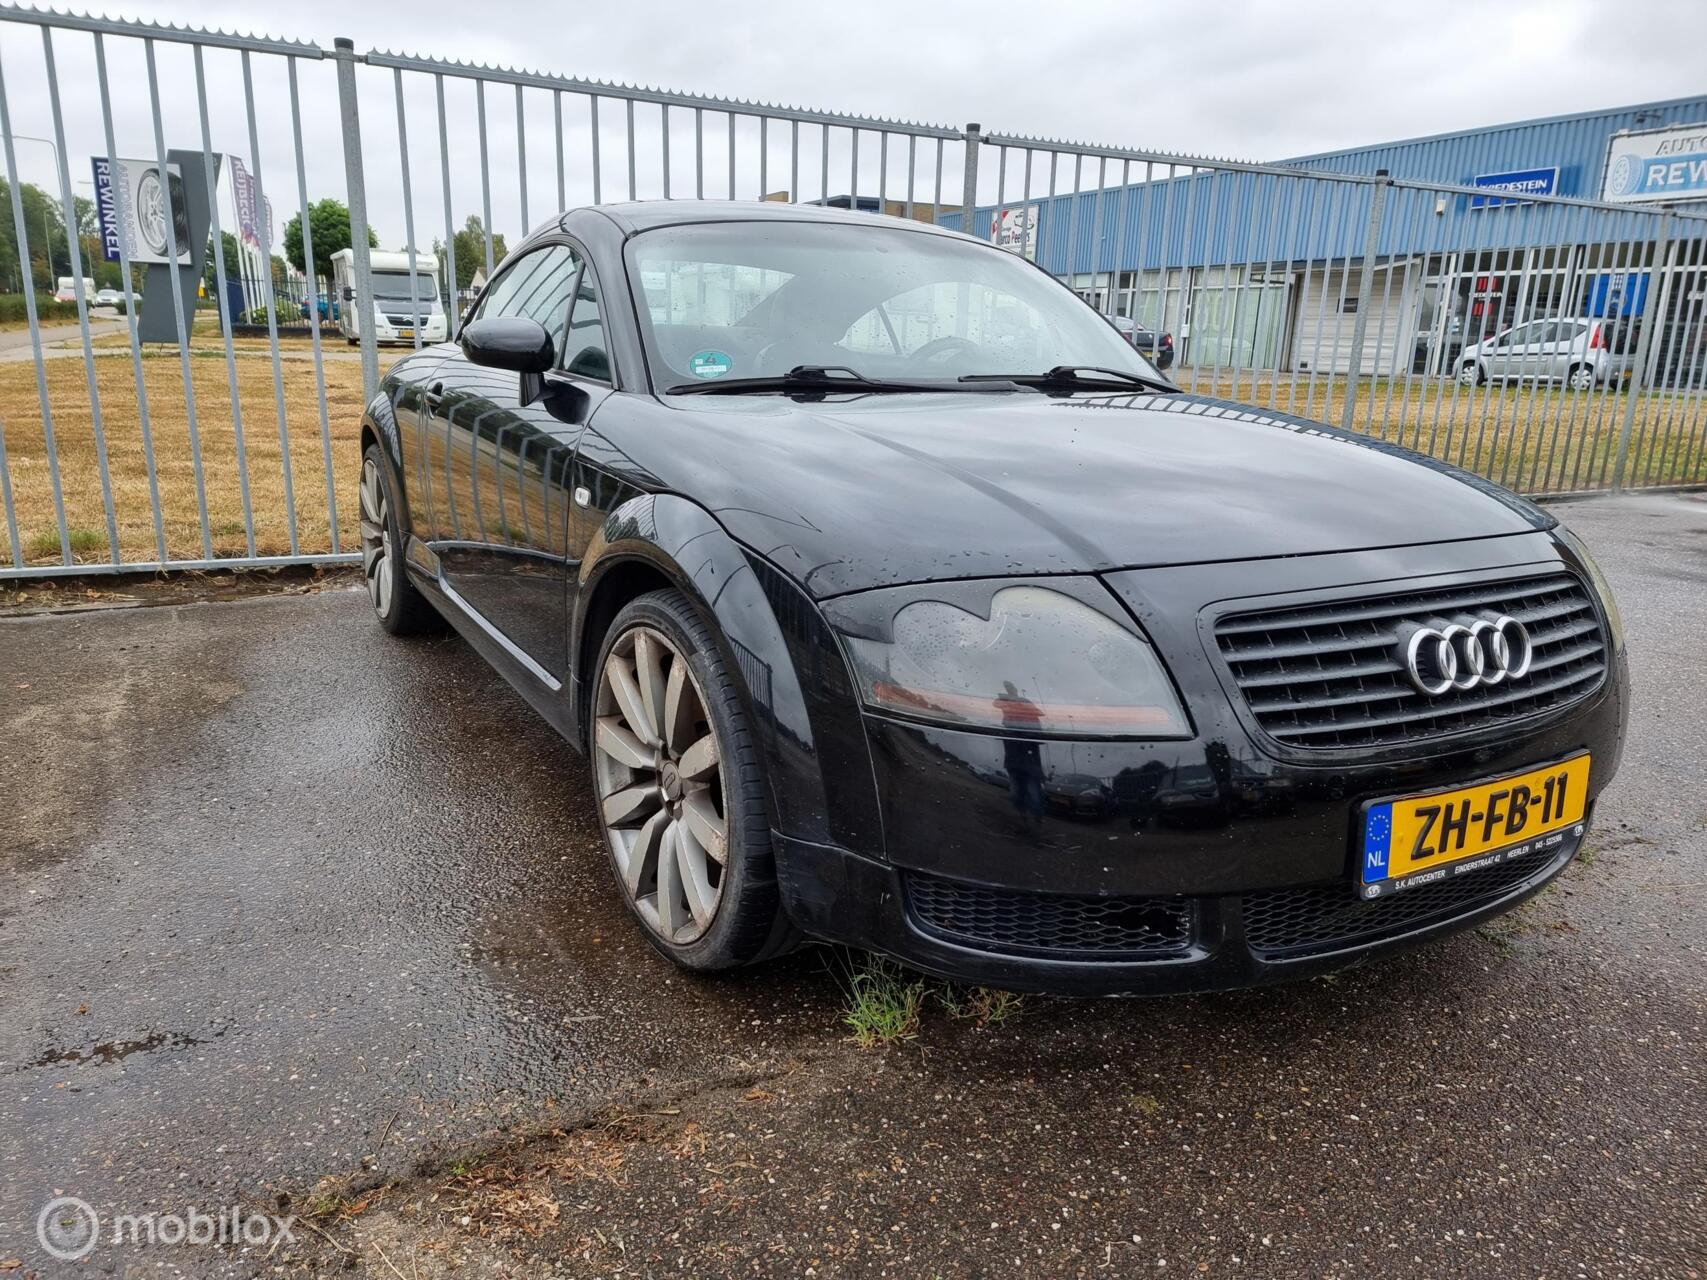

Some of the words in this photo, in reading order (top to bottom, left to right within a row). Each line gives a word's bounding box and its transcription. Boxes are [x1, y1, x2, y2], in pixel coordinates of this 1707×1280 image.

[97, 162, 119, 258] REWINKEL
[1411, 771, 1568, 860] ZH-FB-11
[1367, 850, 1385, 868] NL
[1407, 870, 1446, 887] AUTOCENTER
[1507, 845, 1529, 859] HEERLEN
